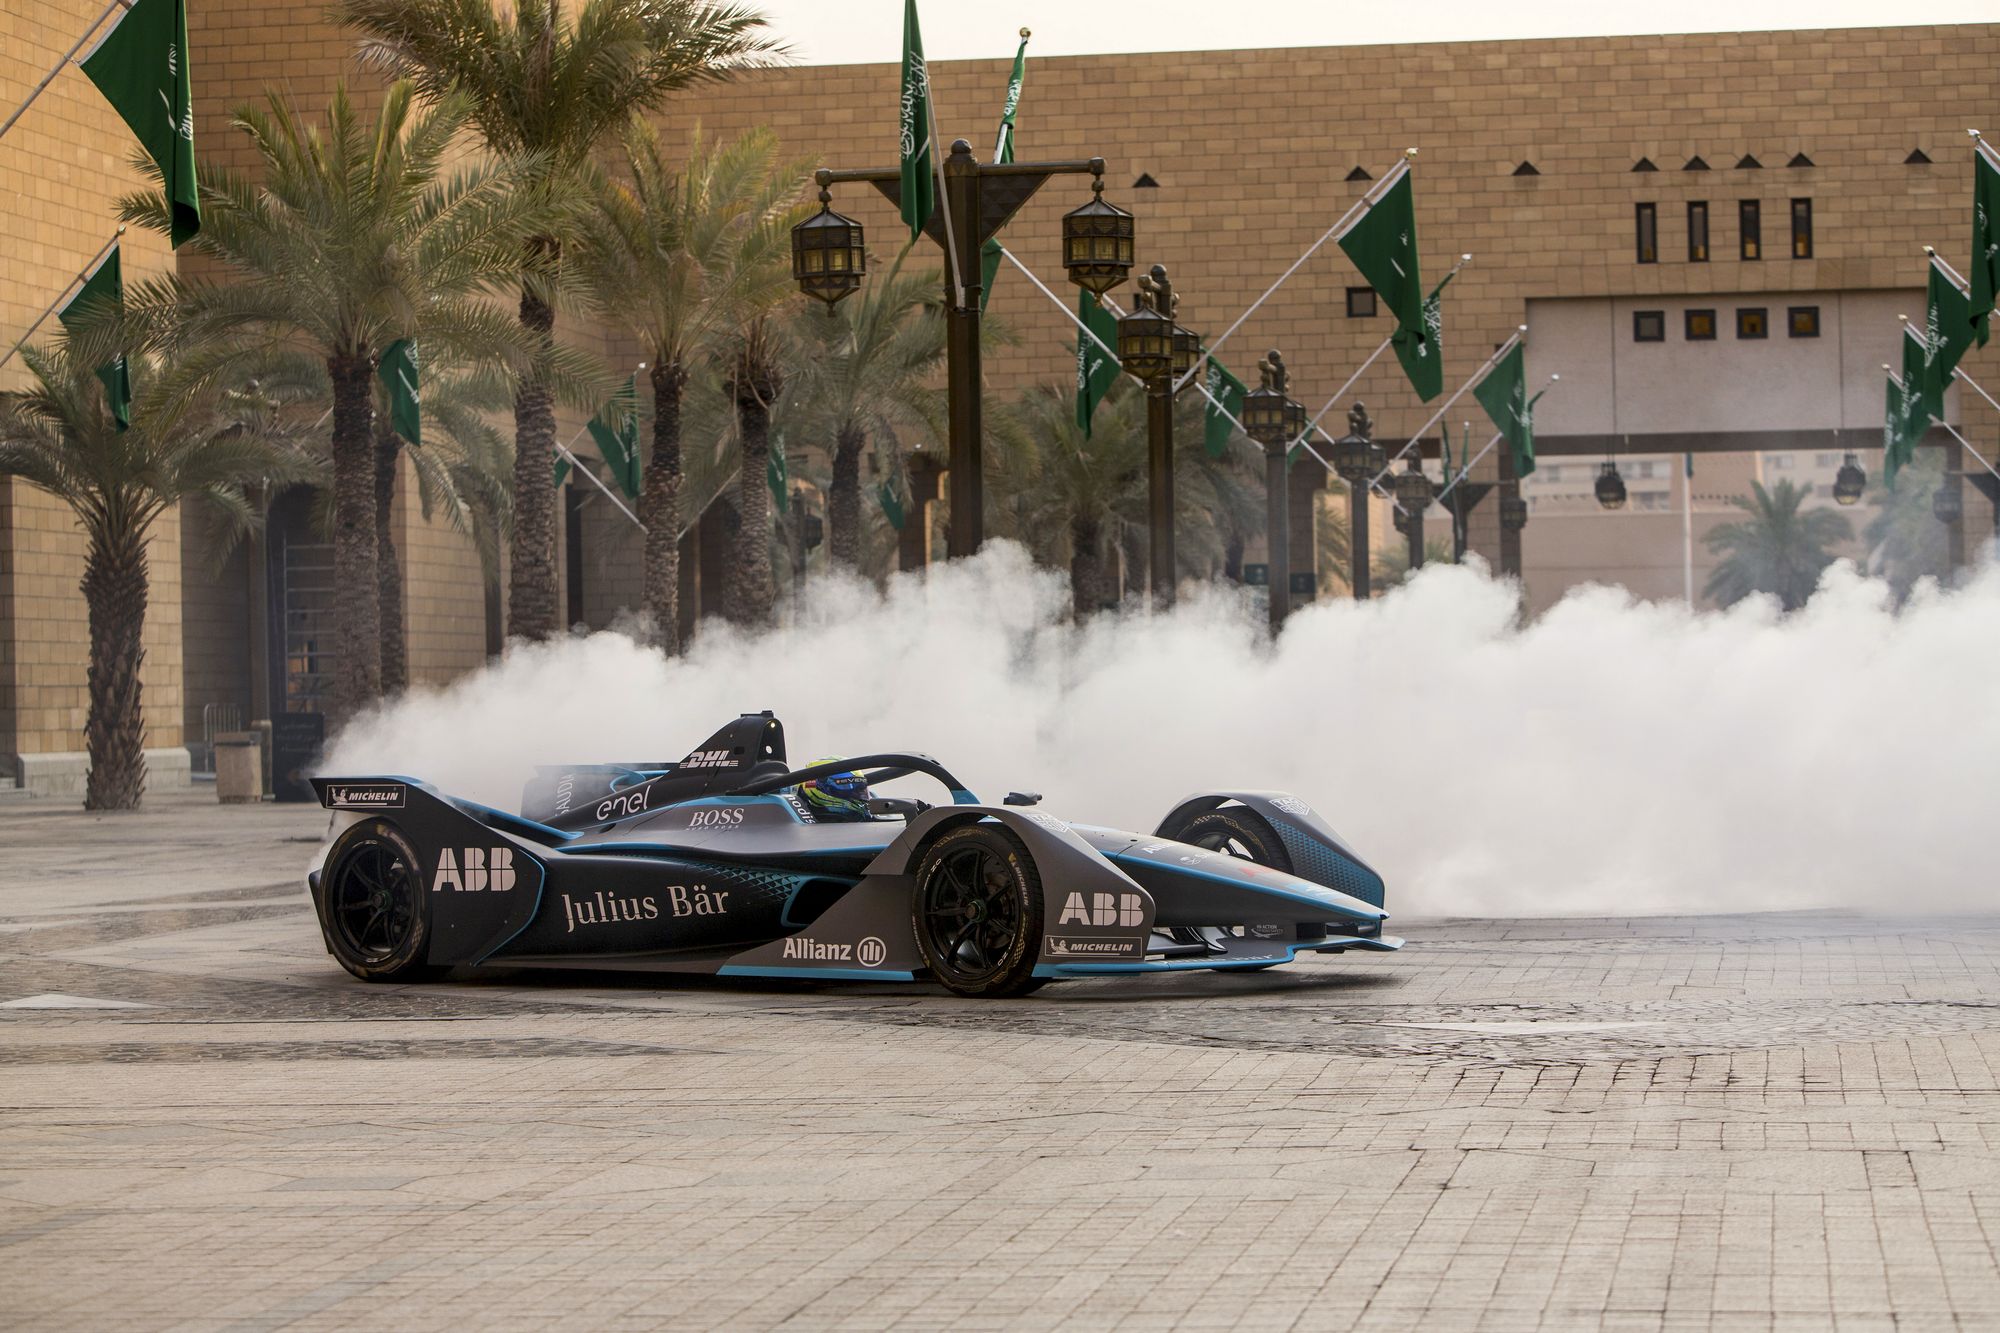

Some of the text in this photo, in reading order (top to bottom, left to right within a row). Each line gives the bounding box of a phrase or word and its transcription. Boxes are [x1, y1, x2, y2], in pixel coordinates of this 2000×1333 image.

[686, 750, 731, 768] DHL
[349, 791, 399, 802] MICHELIN
[596, 785, 651, 820] enel
[689, 807, 744, 827] BOSS
[432, 847, 516, 892] ABB
[562, 884, 729, 933] Julius Bär
[1058, 892, 1145, 928] ABB
[783, 937, 852, 961] Allianz
[1070, 942, 1134, 952] MICHELIN
